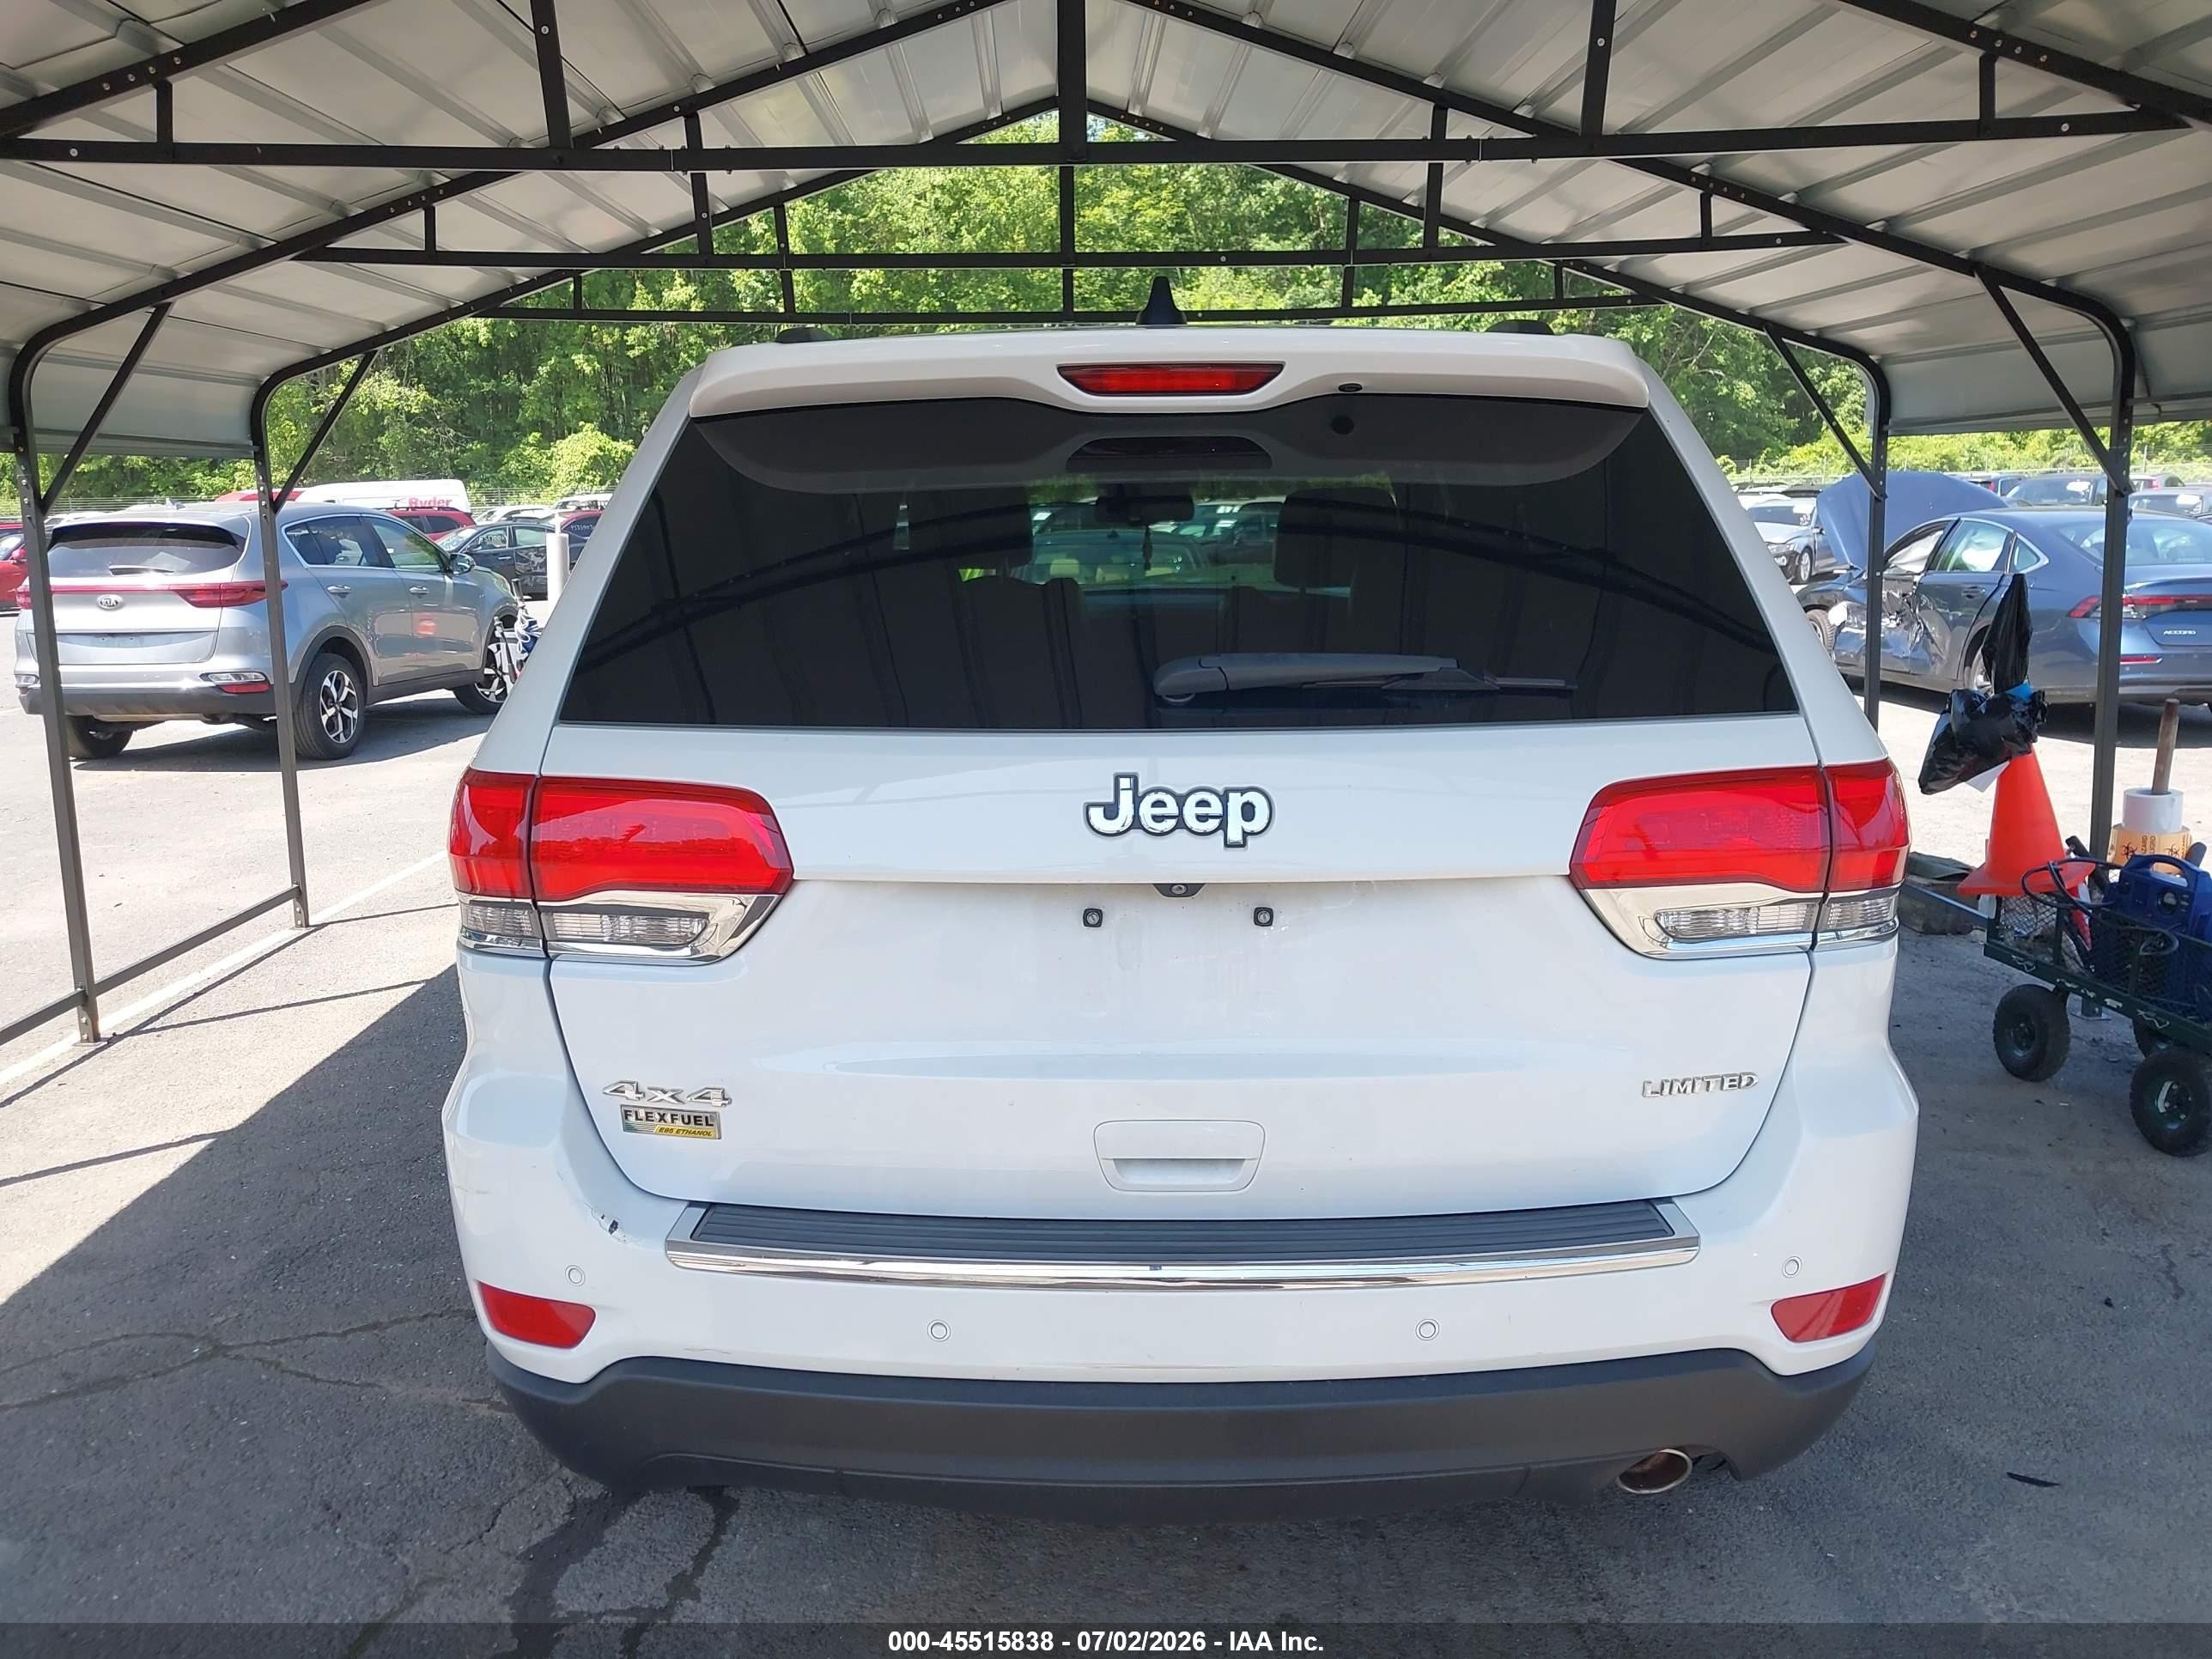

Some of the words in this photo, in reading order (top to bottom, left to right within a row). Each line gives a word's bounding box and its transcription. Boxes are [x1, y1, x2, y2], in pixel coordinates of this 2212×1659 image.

[408, 495, 453, 507] Ryder
[1085, 774, 1273, 848] Jeep
[1642, 1072, 1759, 1098] LIMITED
[624, 1109, 714, 1127] FLEXFUEL
[675, 1128, 714, 1137] ETHANOL
